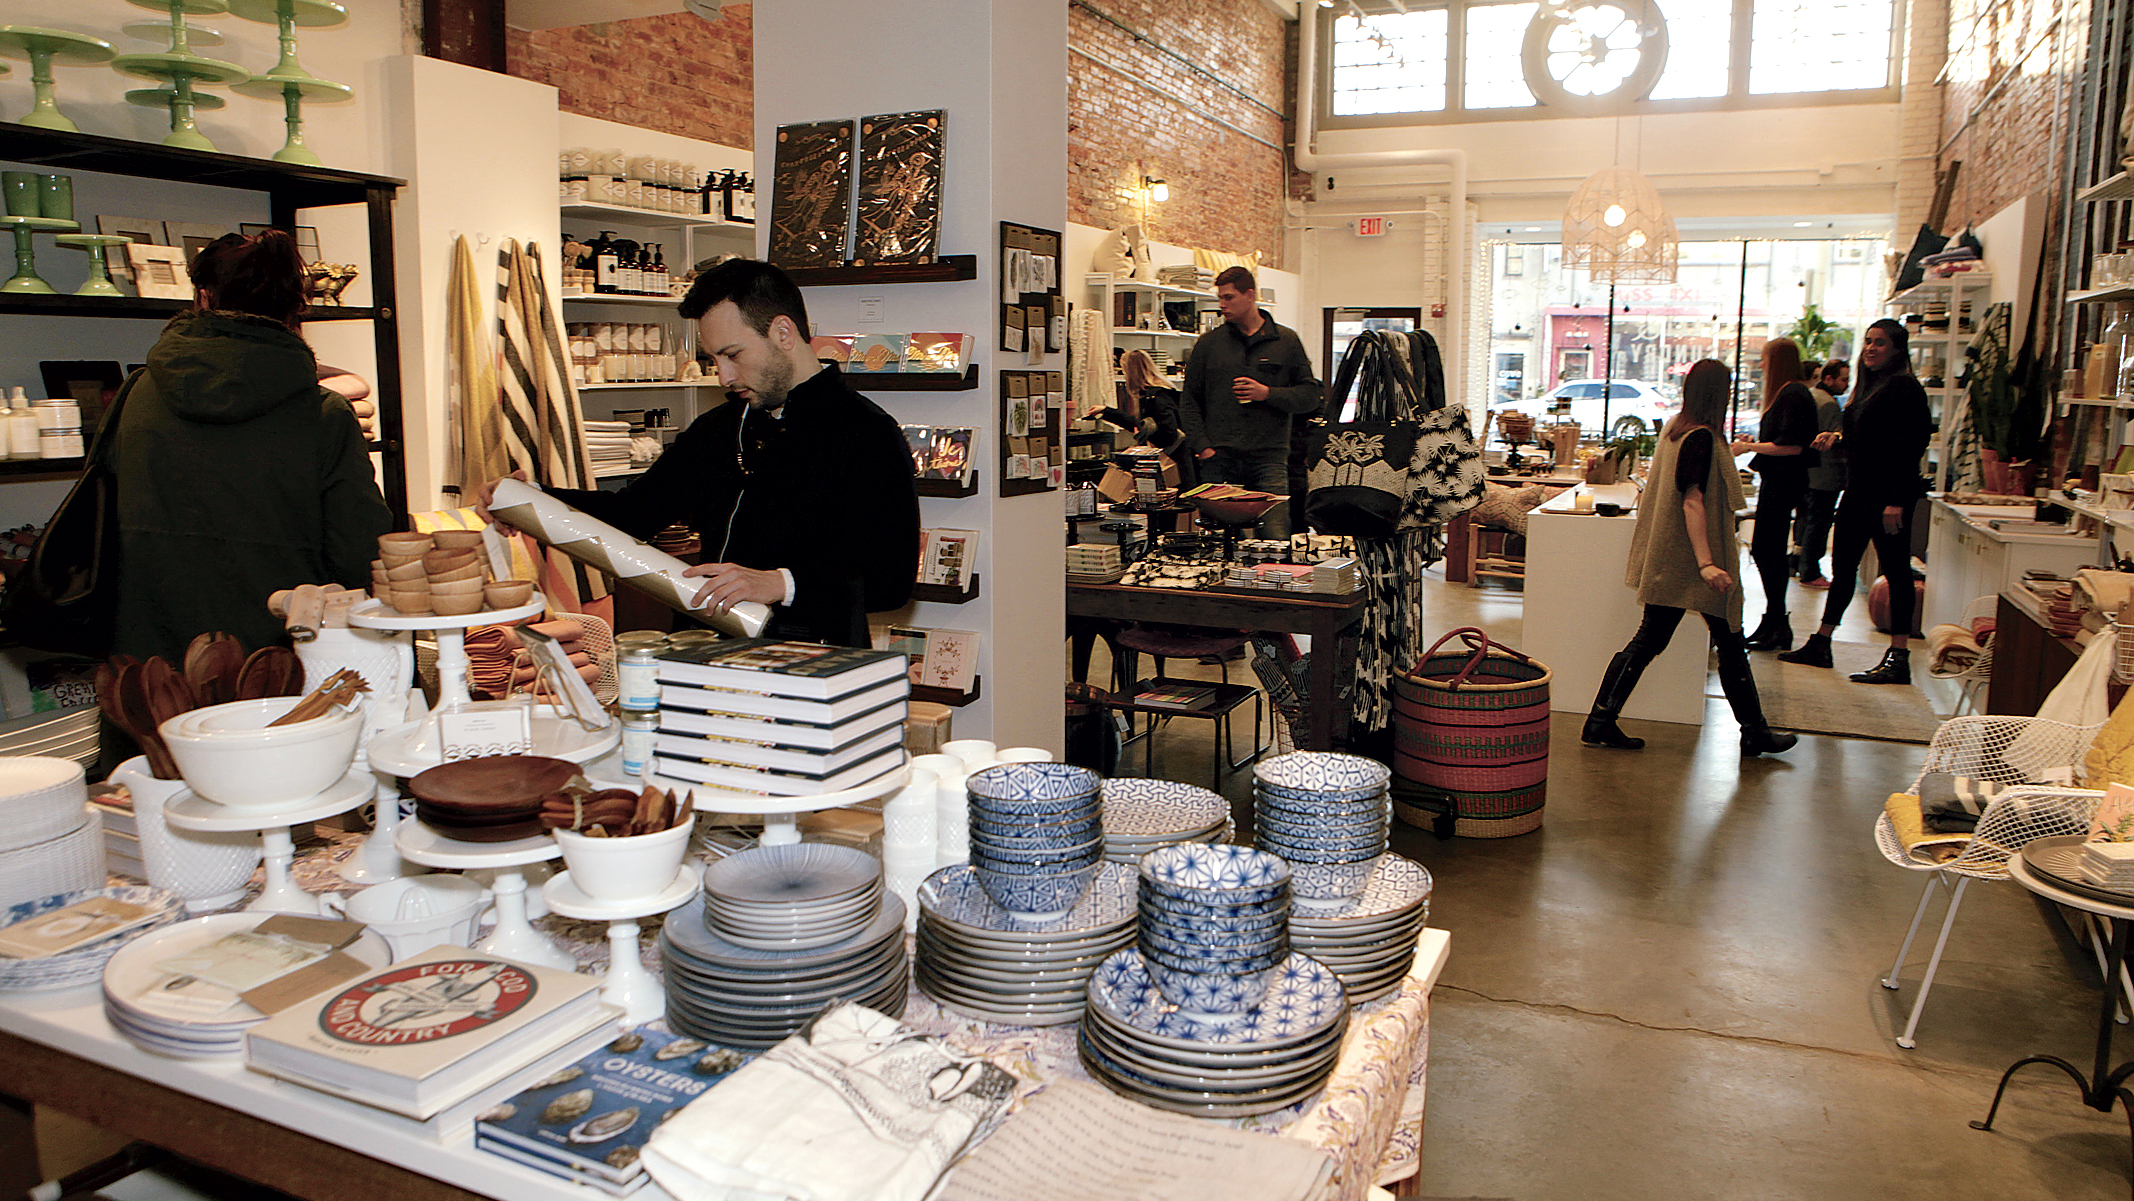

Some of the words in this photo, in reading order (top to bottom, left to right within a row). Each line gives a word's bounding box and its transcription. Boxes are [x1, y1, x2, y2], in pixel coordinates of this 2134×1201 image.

[1360, 217, 1382, 235] EXIT
[419, 962, 476, 977] FOR
[330, 998, 361, 1024] AND
[336, 1021, 451, 1043] COUNTRY
[602, 1057, 708, 1096] OYSTERS
